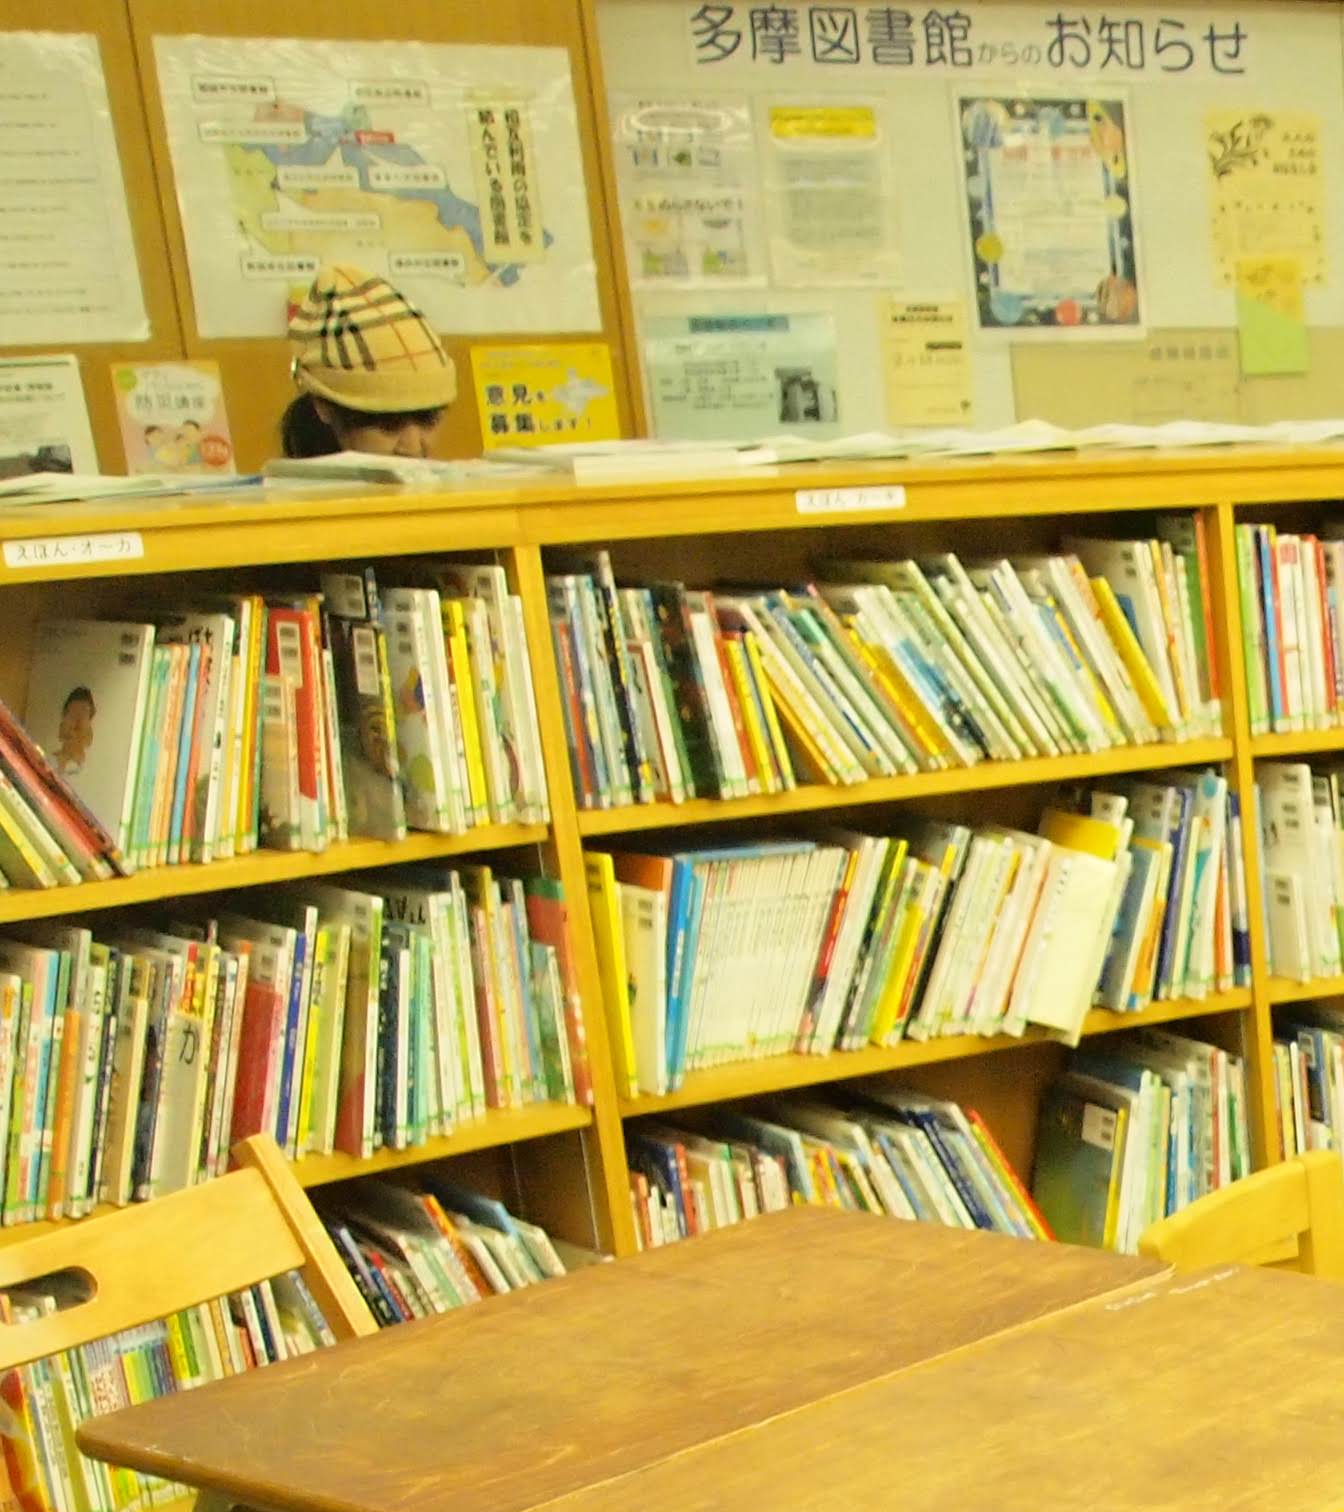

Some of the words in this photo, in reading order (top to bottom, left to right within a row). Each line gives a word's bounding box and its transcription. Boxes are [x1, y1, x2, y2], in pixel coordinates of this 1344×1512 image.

[690, 5, 1248, 75] 多摩図書館からのお知らせ
